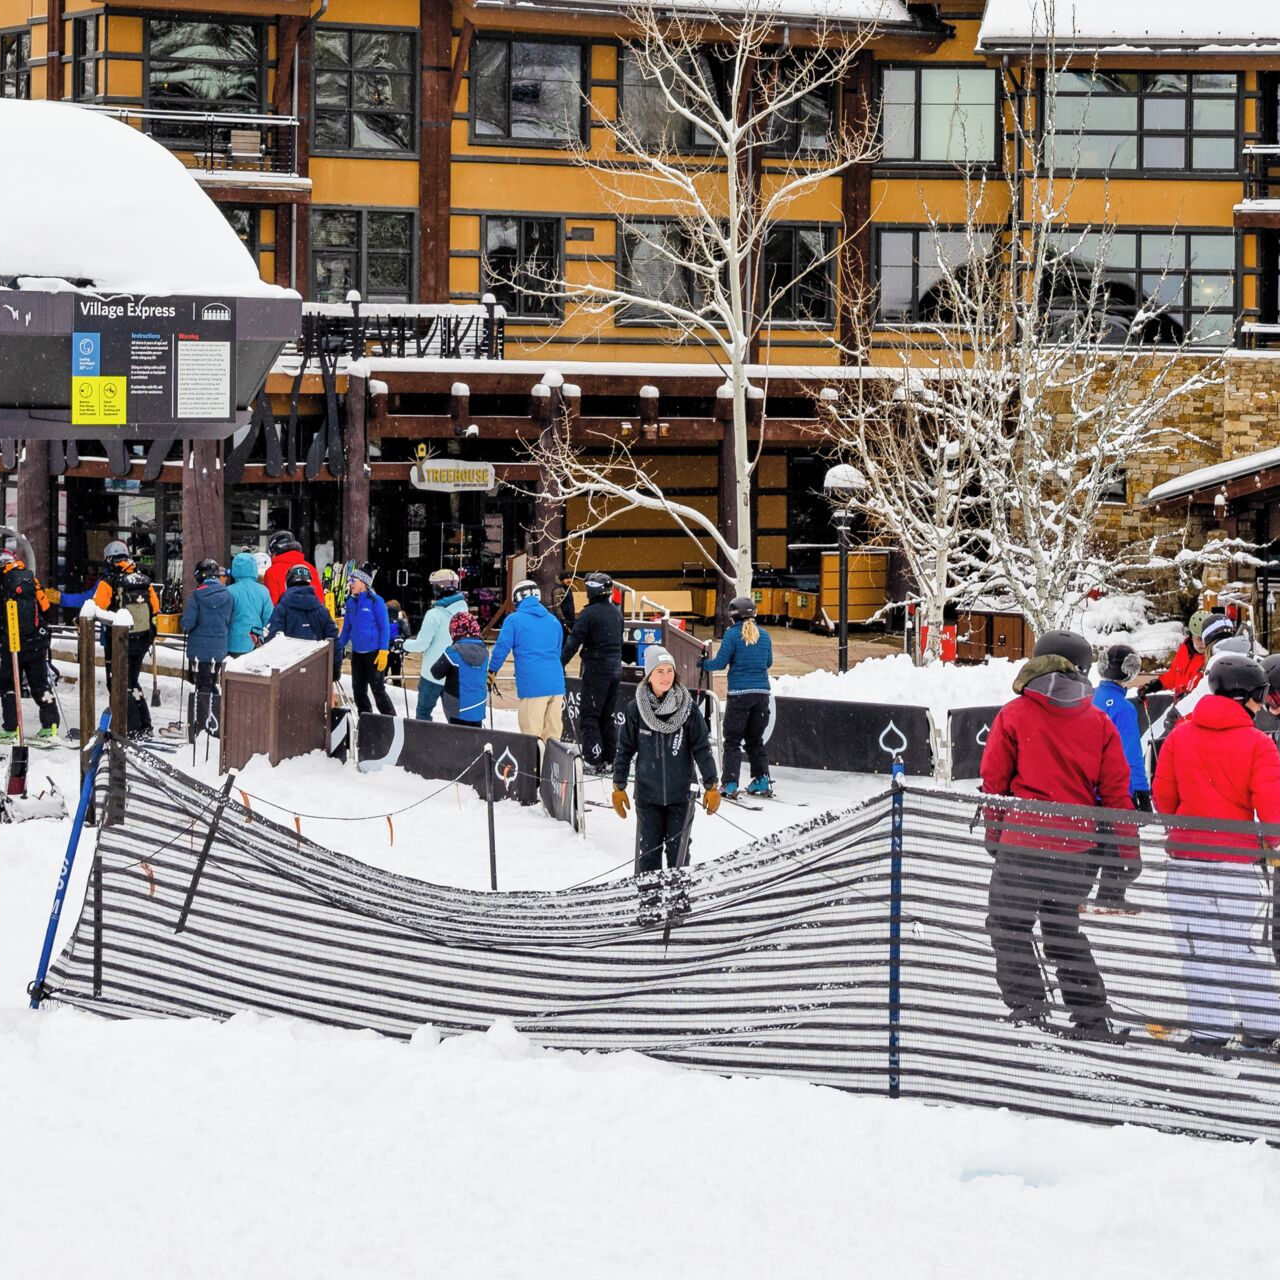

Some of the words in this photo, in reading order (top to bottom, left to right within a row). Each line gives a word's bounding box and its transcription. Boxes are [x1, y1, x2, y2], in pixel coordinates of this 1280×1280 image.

[80, 302, 124, 319] Village
[128, 303, 176, 319] Express
[426, 468, 489, 483] TREEHOUSE
